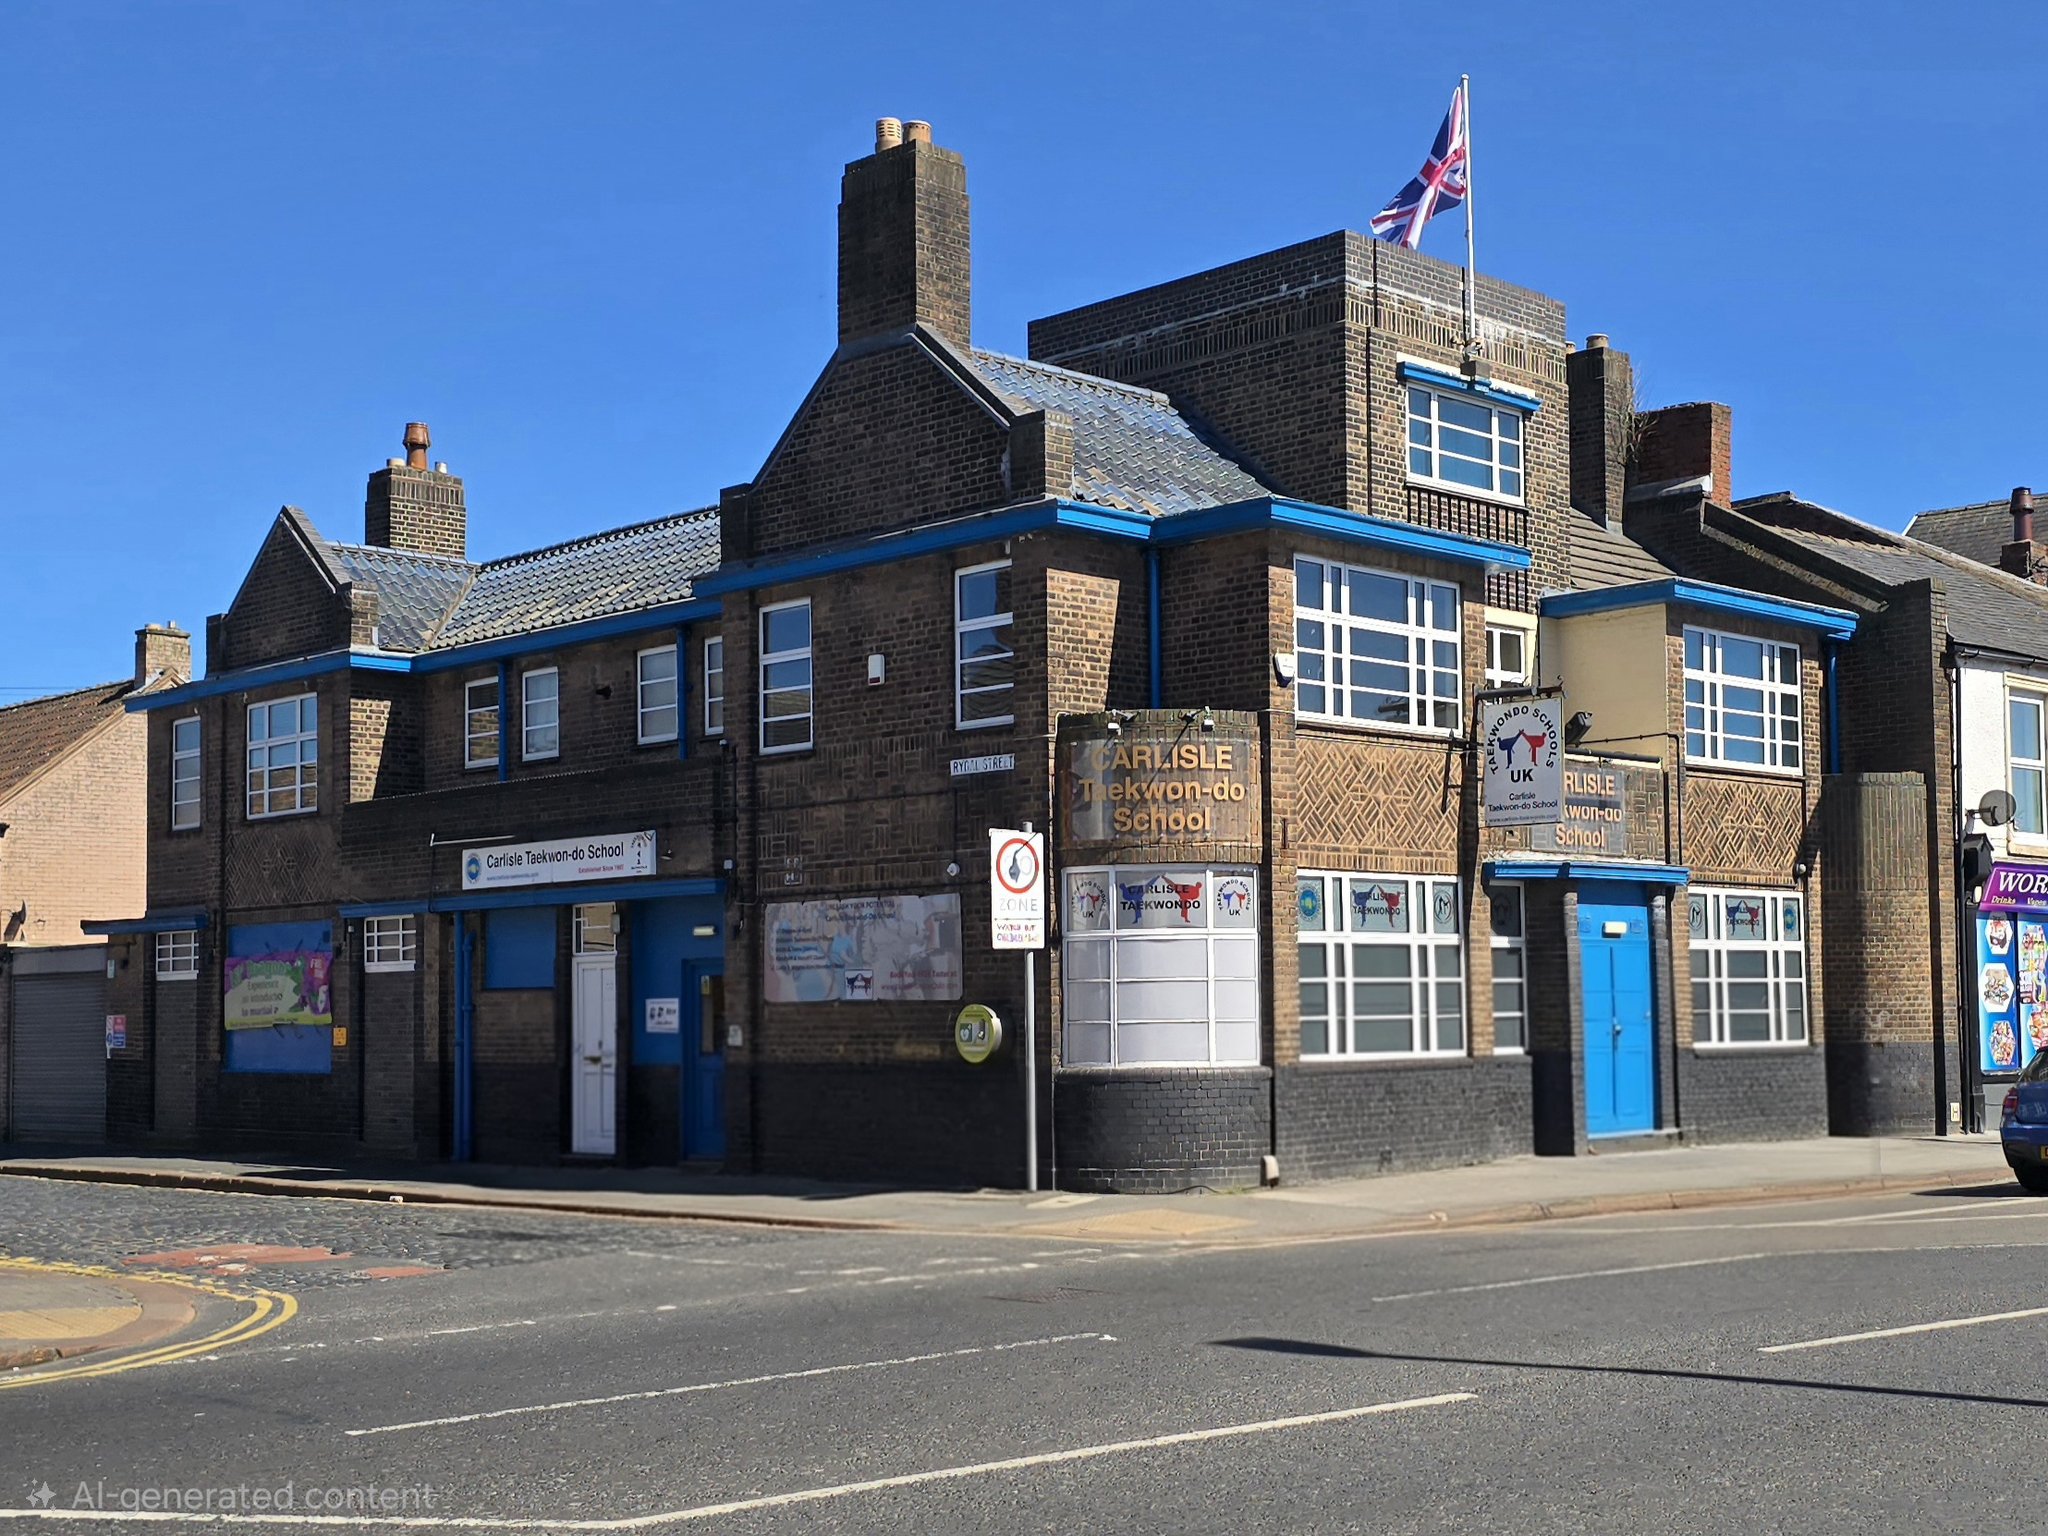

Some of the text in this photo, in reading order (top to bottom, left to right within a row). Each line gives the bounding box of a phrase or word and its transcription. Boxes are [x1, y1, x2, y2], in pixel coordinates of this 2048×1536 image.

[1487, 705, 1558, 775] TAEKWONDO SCHOOLS
[1091, 744, 1233, 771] CARLISLE
[1510, 769, 1534, 783] UK
[1564, 771, 1616, 796] RLISLE
[1078, 776, 1246, 802] Taekwon-do
[1508, 791, 1536, 801] Carlisle
[1488, 800, 1558, 812] Taekwon-do School
[1114, 804, 1211, 832] School
[1555, 823, 1606, 847] School
[486, 842, 625, 869] Carlisle Taekwon-do School
[1128, 884, 1190, 895] CARLISLE
[1999, 871, 2048, 894] WOR
[1000, 898, 1038, 912] ZONE
[1120, 900, 1202, 911] TAEKWONDO
[1217, 879, 1239, 911] TAEKWONDO
[1082, 911, 1094, 919] UK
[1352, 905, 1401, 915] TAEKWONDO
